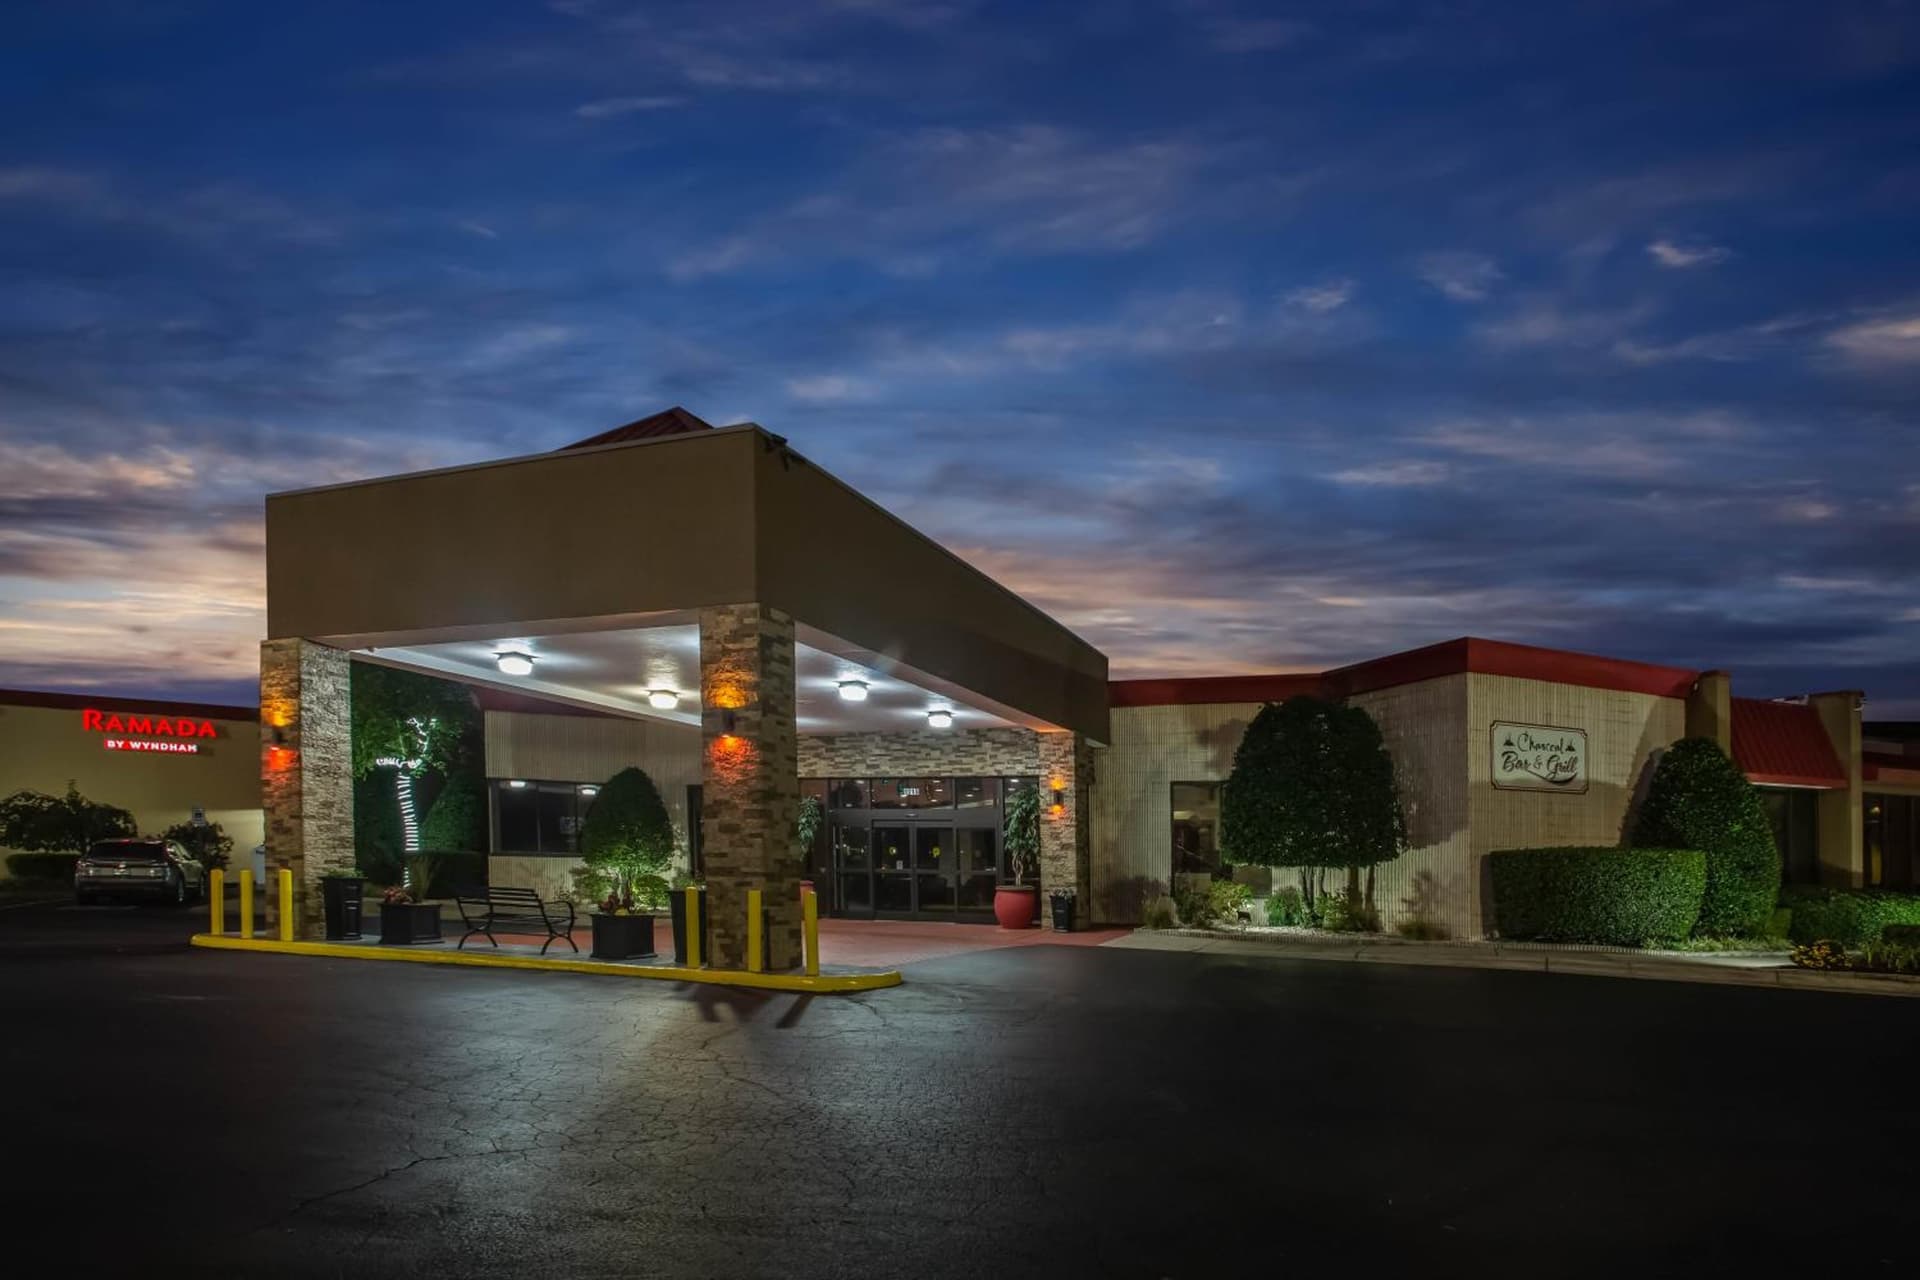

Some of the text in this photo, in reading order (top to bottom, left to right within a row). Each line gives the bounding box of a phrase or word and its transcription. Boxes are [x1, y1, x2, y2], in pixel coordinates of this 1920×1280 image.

[83, 709, 216, 737] RAMADA
[106, 740, 198, 752] BY WYNDHAM
[1517, 732, 1564, 754] Charcoal
[1502, 751, 1578, 780] Bar & Grill
